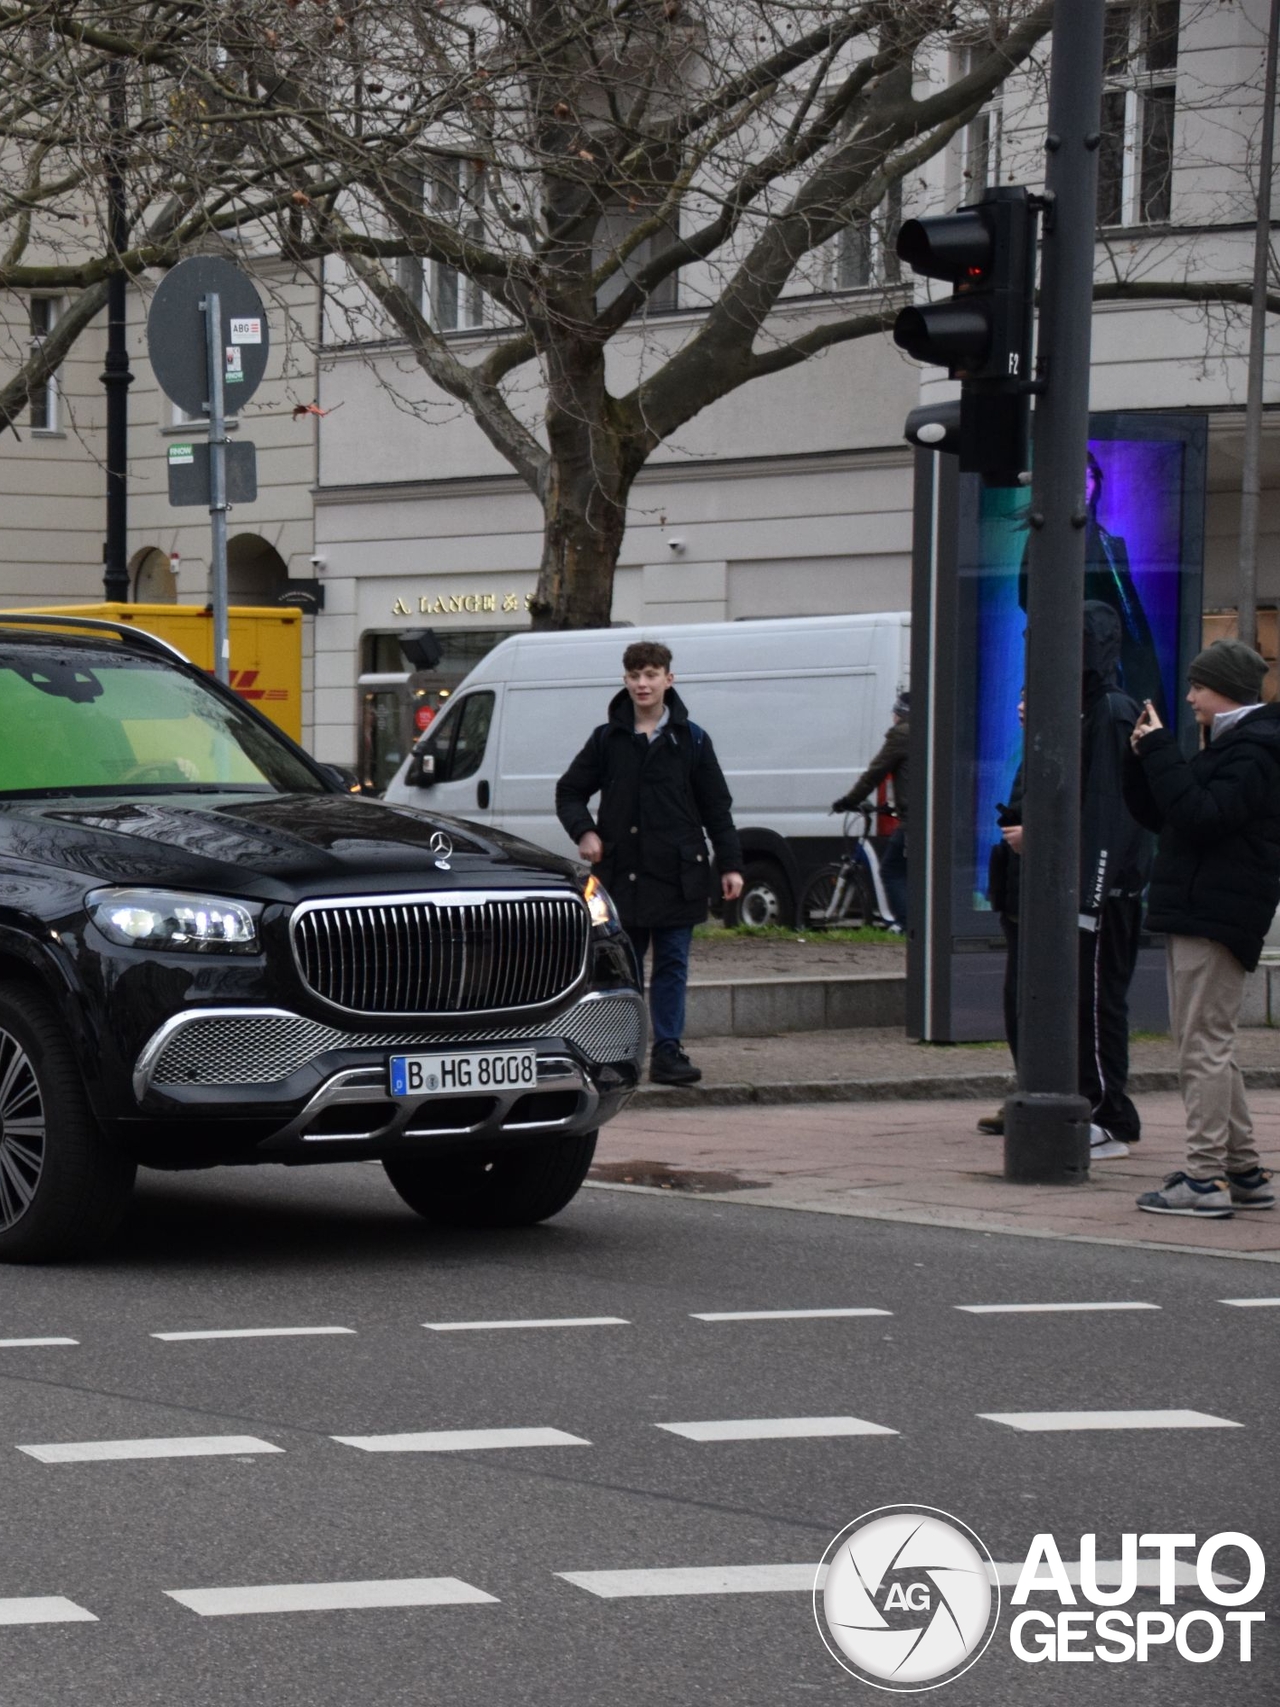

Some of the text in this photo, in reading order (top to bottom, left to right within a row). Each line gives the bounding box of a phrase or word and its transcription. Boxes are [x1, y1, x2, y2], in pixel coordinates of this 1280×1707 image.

[232, 324, 250, 333] ABG
[1008, 352, 1019, 375] F2
[418, 593, 496, 613] LANGE
[408, 1055, 533, 1090] B HG 8008
